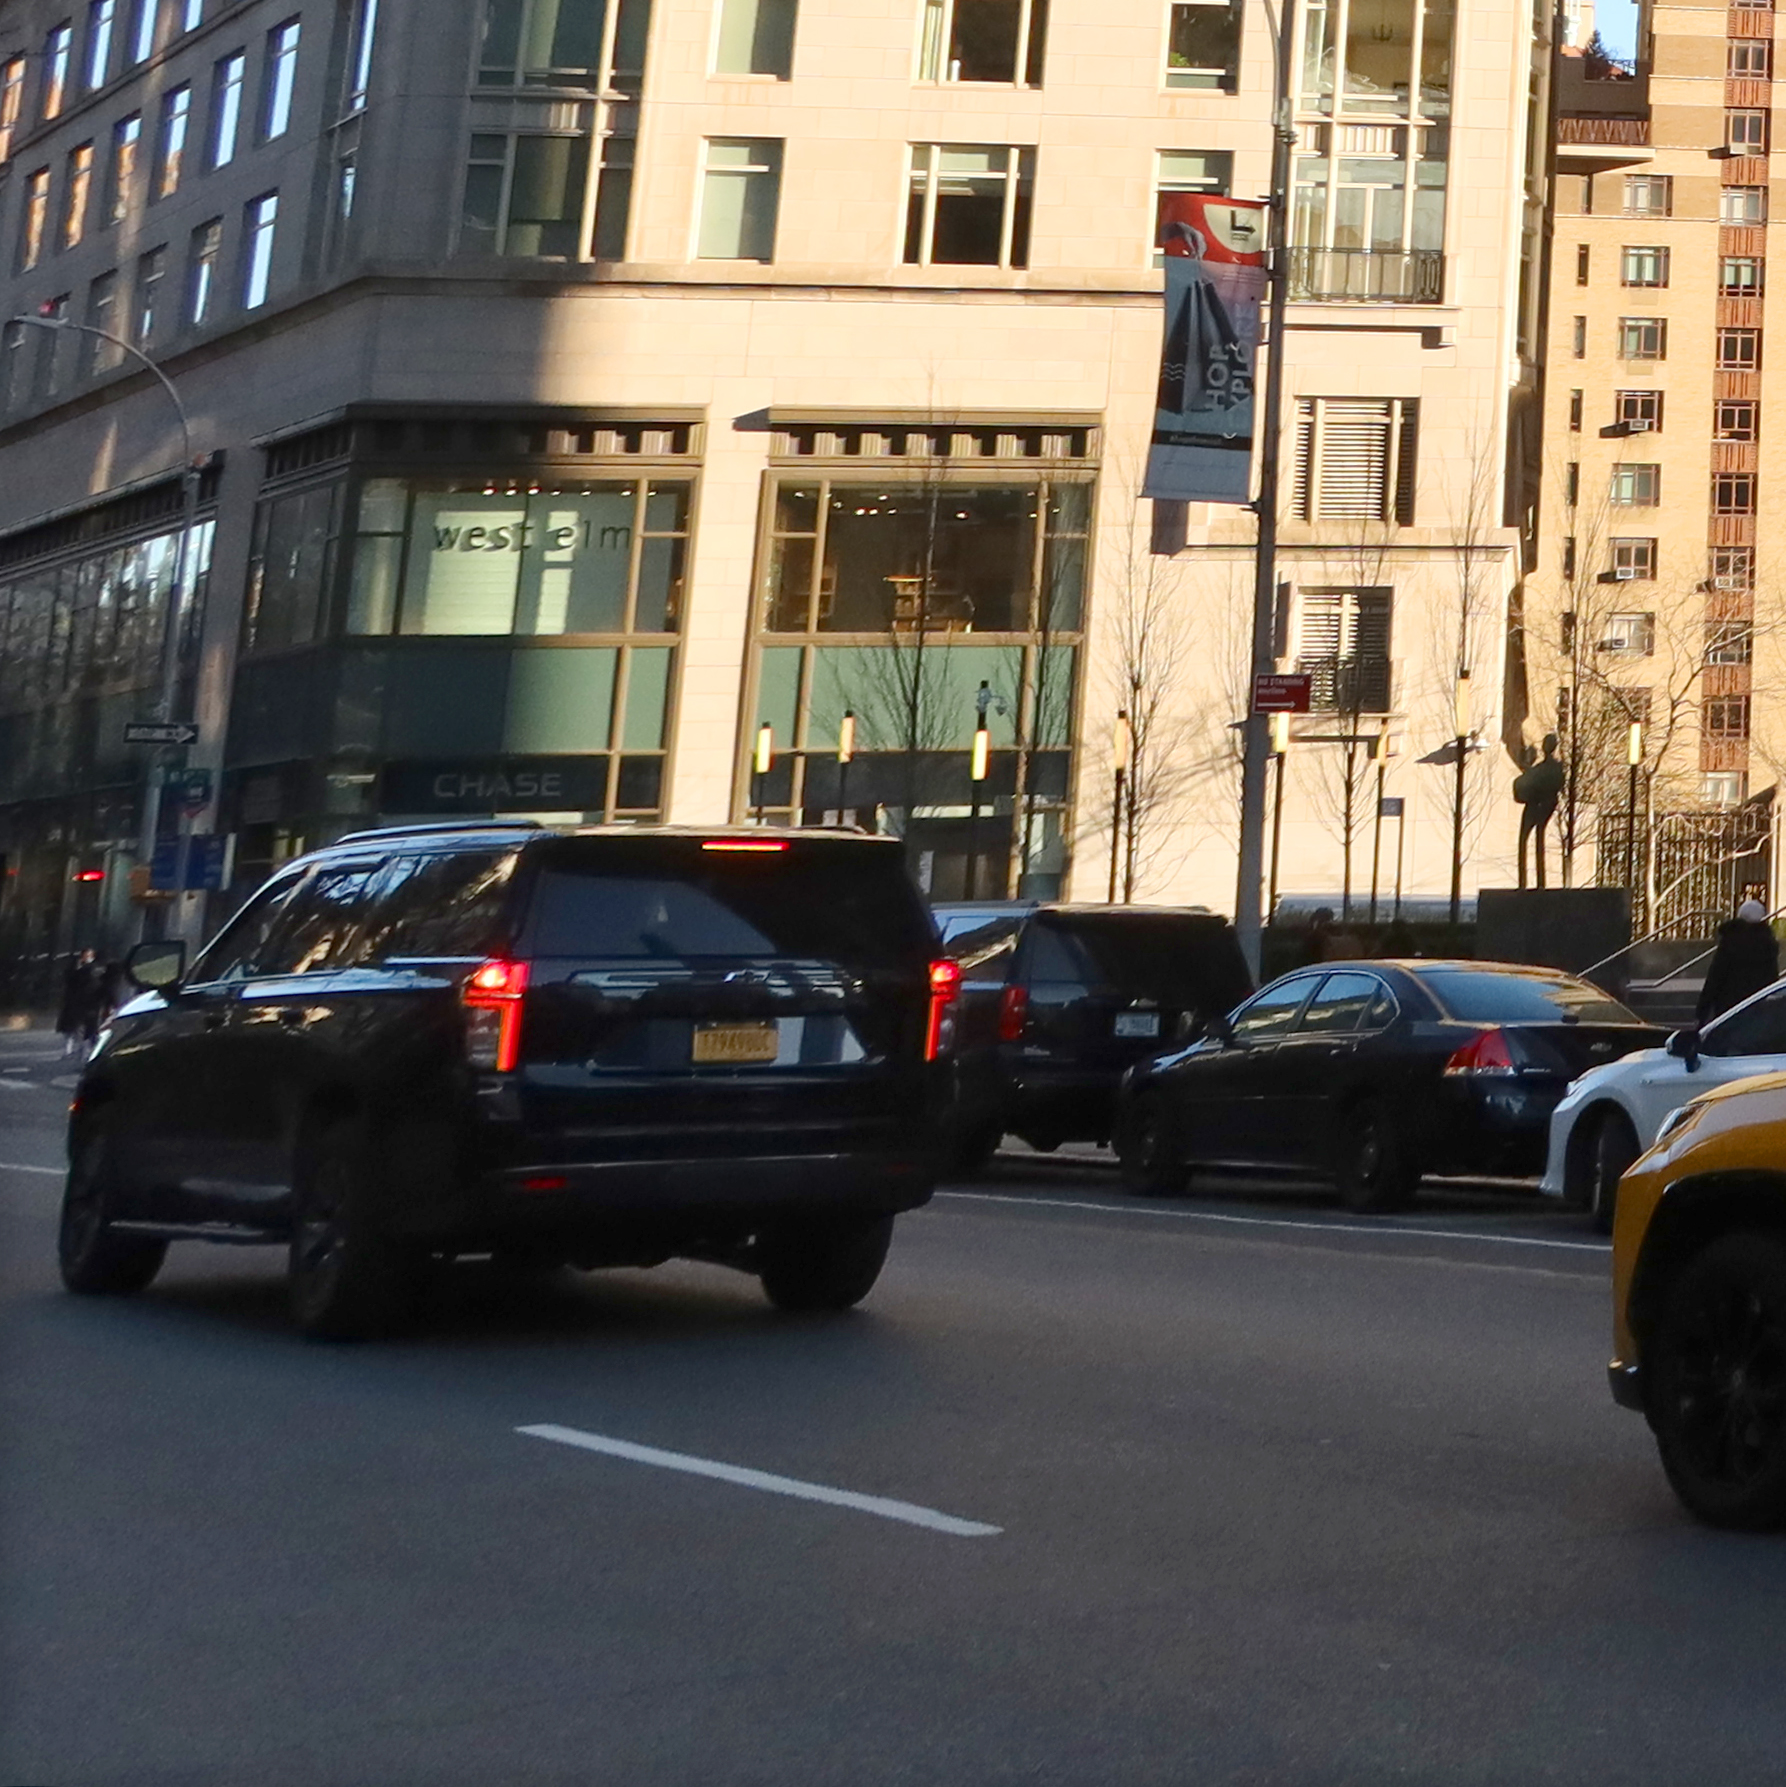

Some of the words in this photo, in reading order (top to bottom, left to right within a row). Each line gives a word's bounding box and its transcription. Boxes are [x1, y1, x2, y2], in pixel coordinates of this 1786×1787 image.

[434, 523, 534, 550] west
[557, 520, 631, 550] elm
[434, 774, 561, 797] CHASE
